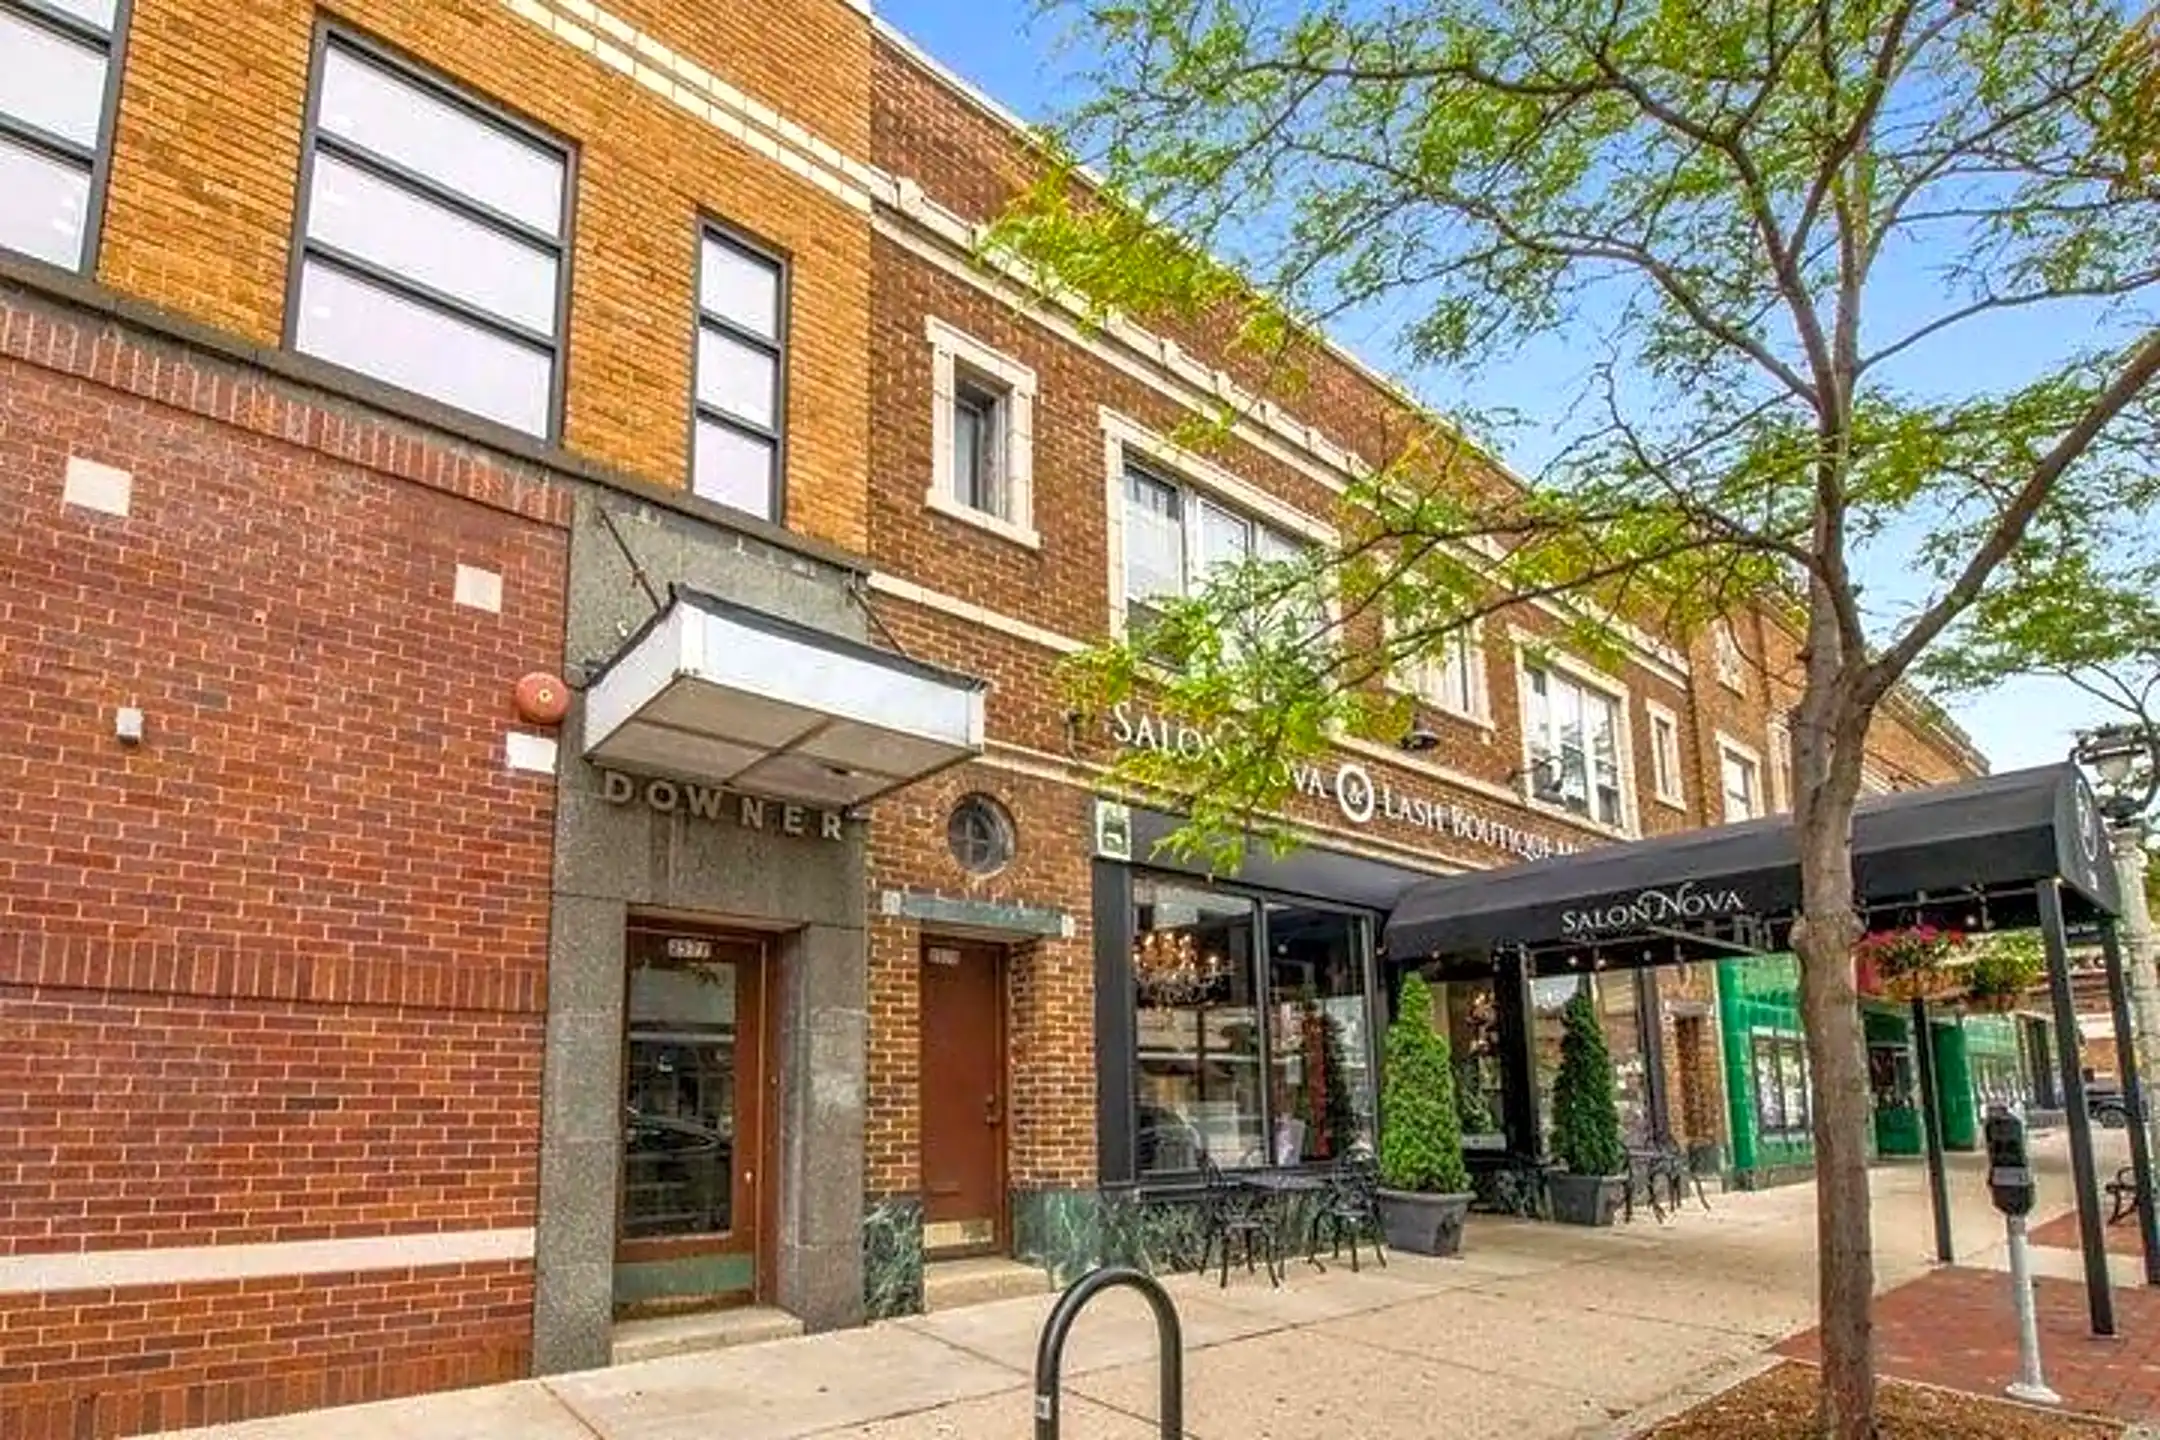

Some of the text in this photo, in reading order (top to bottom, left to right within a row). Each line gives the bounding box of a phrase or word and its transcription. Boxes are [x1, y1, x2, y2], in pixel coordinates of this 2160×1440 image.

[603, 769, 842, 841] DOWNER
[1384, 787, 1445, 833] LASH
[1449, 805, 1553, 862] BOUTIQUE
[1560, 881, 1746, 934] SALON NOVA
